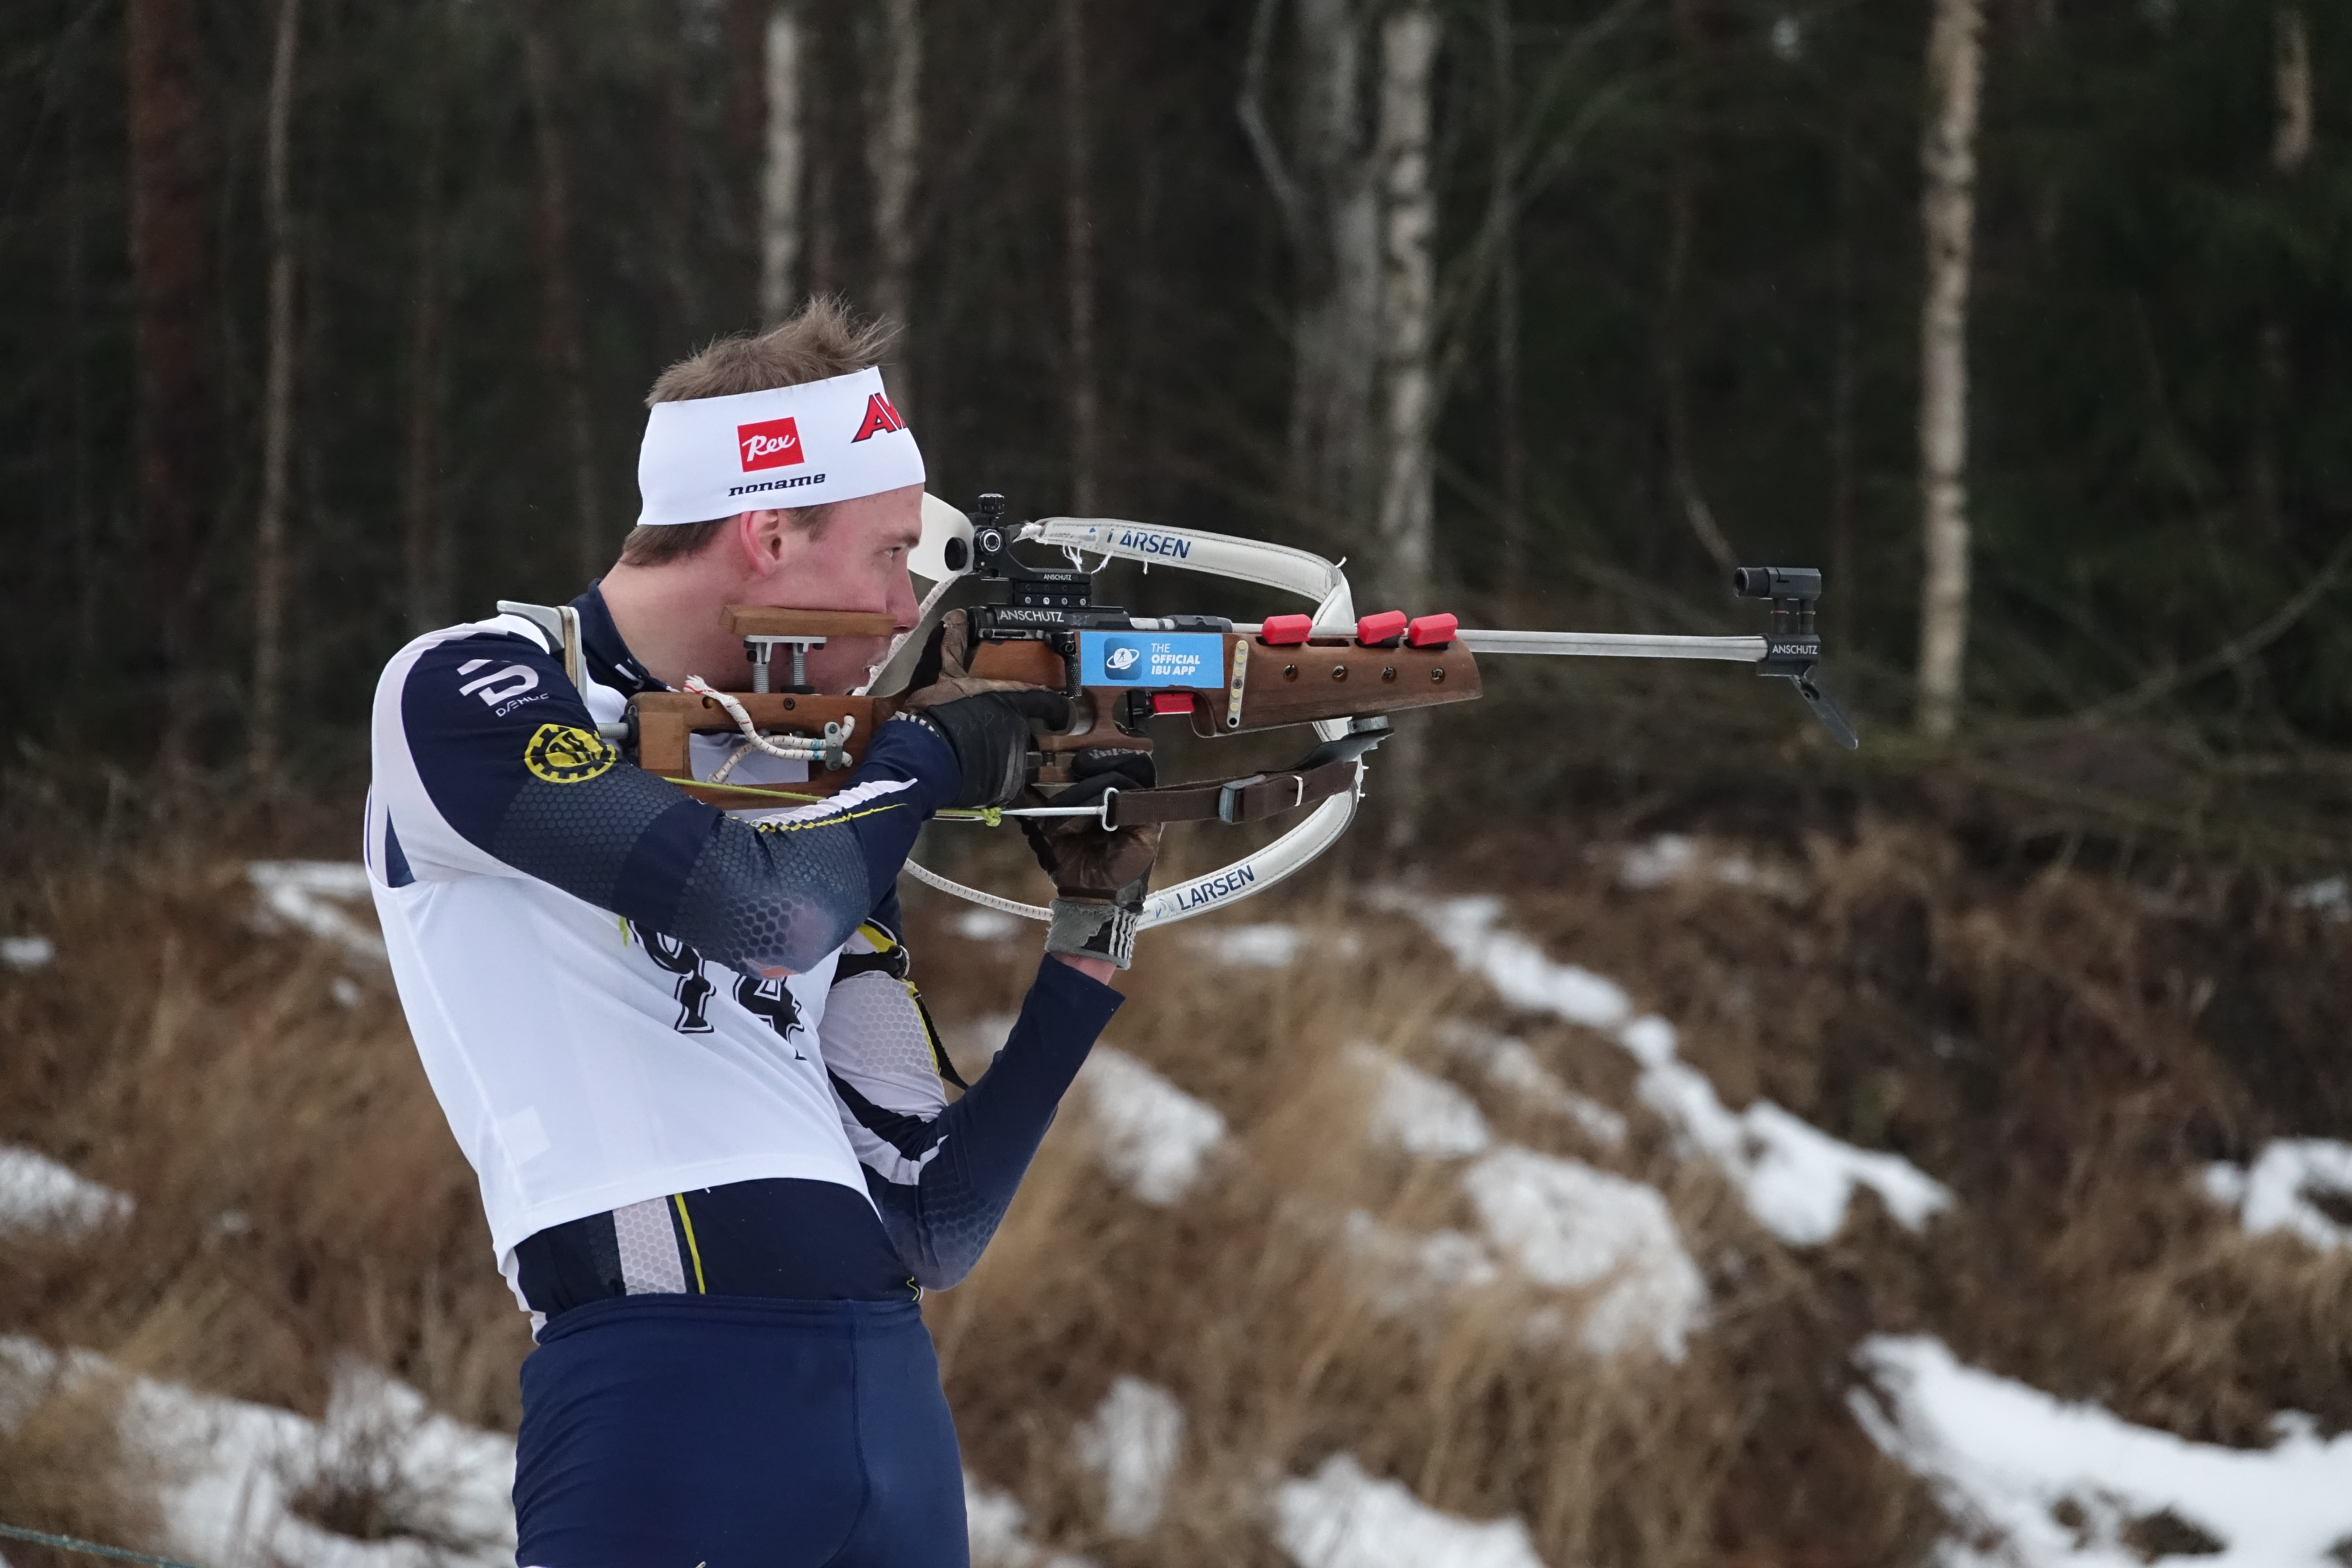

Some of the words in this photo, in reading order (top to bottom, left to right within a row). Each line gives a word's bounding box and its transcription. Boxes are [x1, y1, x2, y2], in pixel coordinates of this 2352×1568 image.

[742, 435, 796, 462] Rex
[728, 473, 826, 497] noname
[1151, 643, 1170, 652] THE
[1152, 654, 1200, 664] OFFICIAL
[1152, 665, 1170, 675] IBU
[1172, 665, 1195, 675] APP
[1176, 864, 1255, 910] LARSEN
